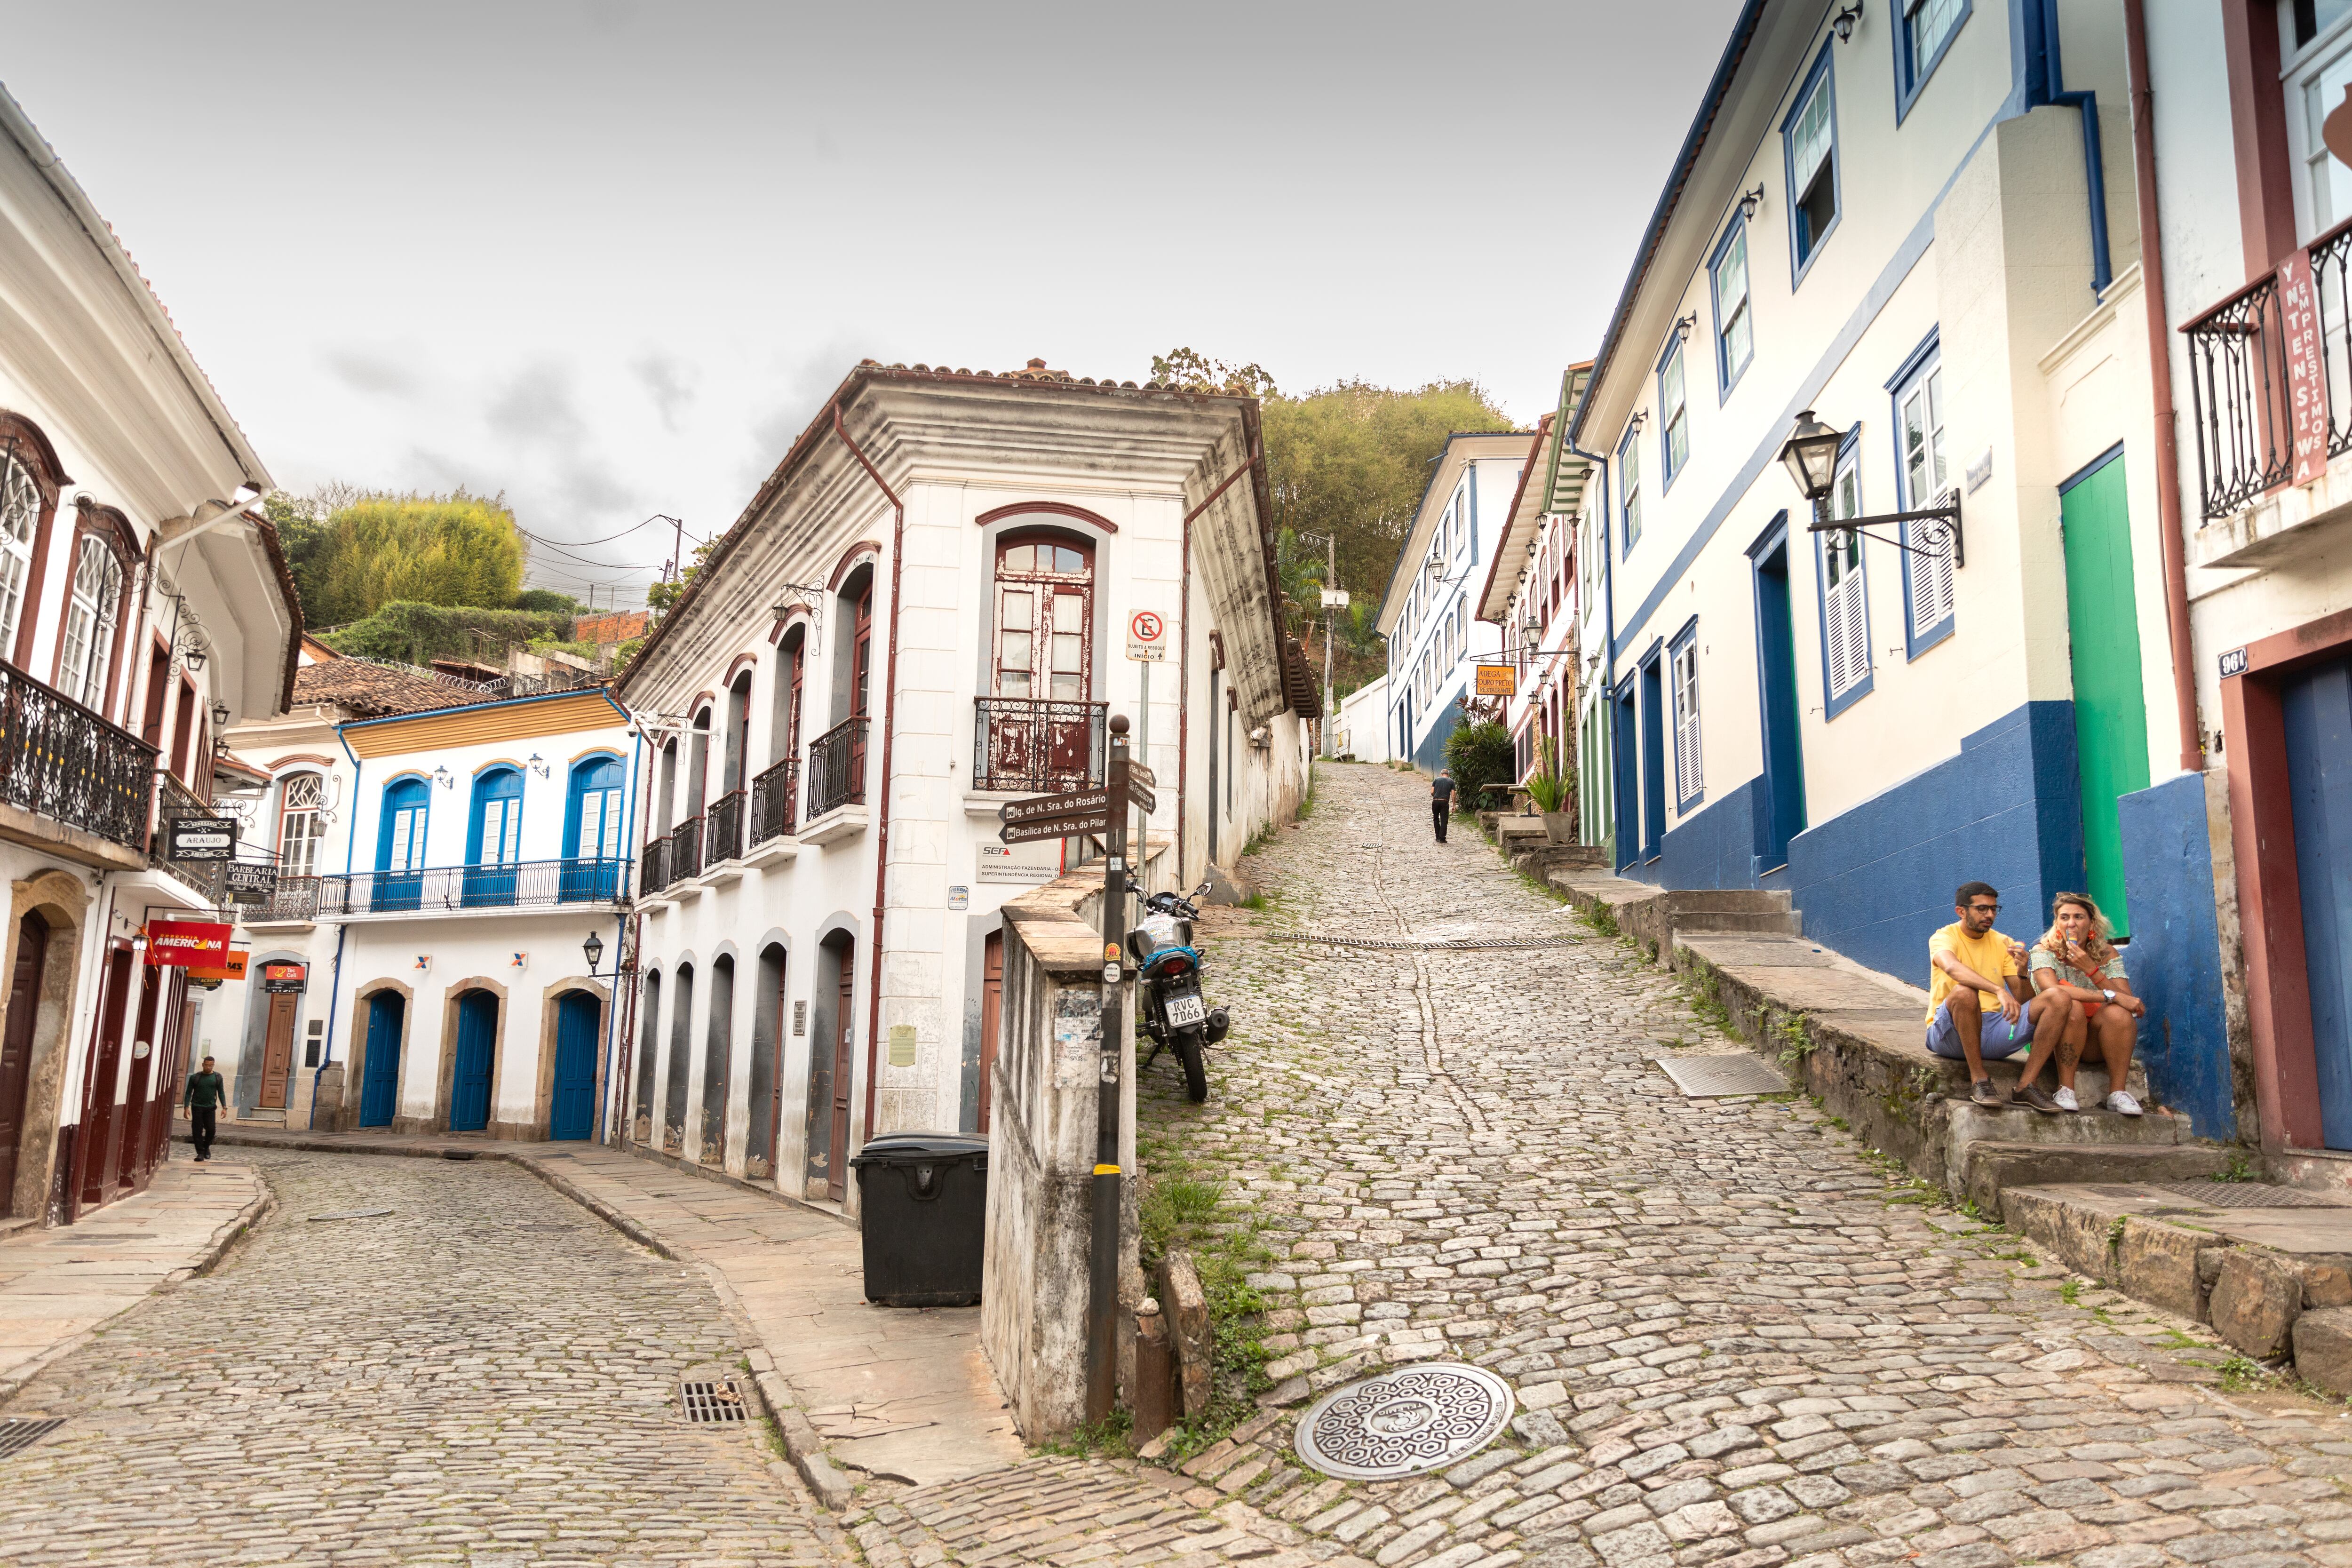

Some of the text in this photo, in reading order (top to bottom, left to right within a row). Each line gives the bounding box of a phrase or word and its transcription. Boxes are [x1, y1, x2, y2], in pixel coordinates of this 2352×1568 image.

[2222, 650, 2244, 674] 961
[1134, 784, 1149, 802] Francisco
[1015, 794, 1106, 817] Ig. de N. Sra. do Rosário
[1016, 827, 1041, 837] Basílica
[1053, 824, 1061, 832] N.
[1063, 822, 1077, 831] Sra.
[1079, 820, 1088, 829] do
[1090, 819, 1106, 828] Pilar
[228, 864, 278, 876] BARBEARIA
[232, 873, 272, 884] CENTRAL
[1174, 998, 1194, 1012] RVC
[1173, 1008, 1200, 1023] 7D66
[1378, 1403, 1423, 1416] TELEMIG
[1462, 1425, 1493, 1449] AMERICANA
